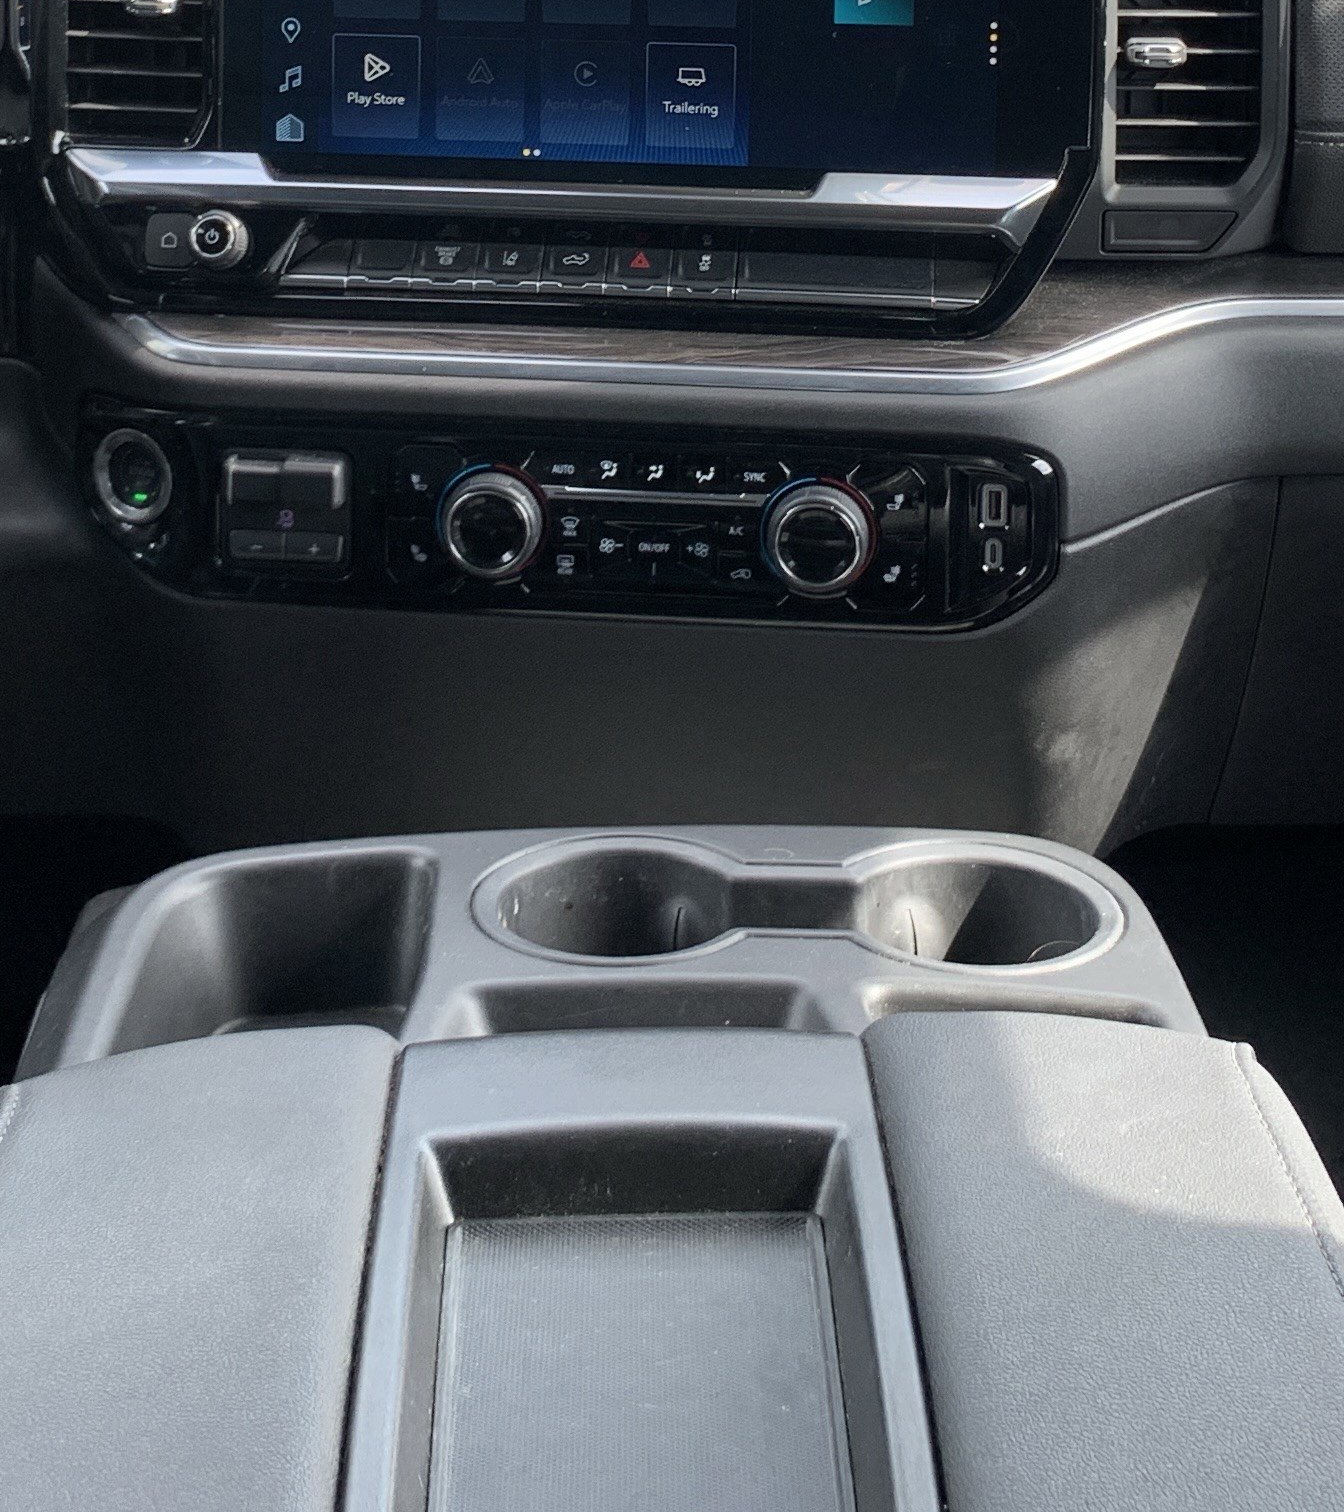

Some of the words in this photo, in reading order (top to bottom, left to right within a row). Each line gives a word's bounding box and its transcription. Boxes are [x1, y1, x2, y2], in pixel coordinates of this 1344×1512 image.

[347, 91, 371, 108] Play
[373, 92, 406, 106] Store
[662, 100, 719, 117] Trailering
[551, 464, 575, 475] AUTO
[743, 471, 767, 483] SYNC
[638, 541, 671, 553] ON/OFF
